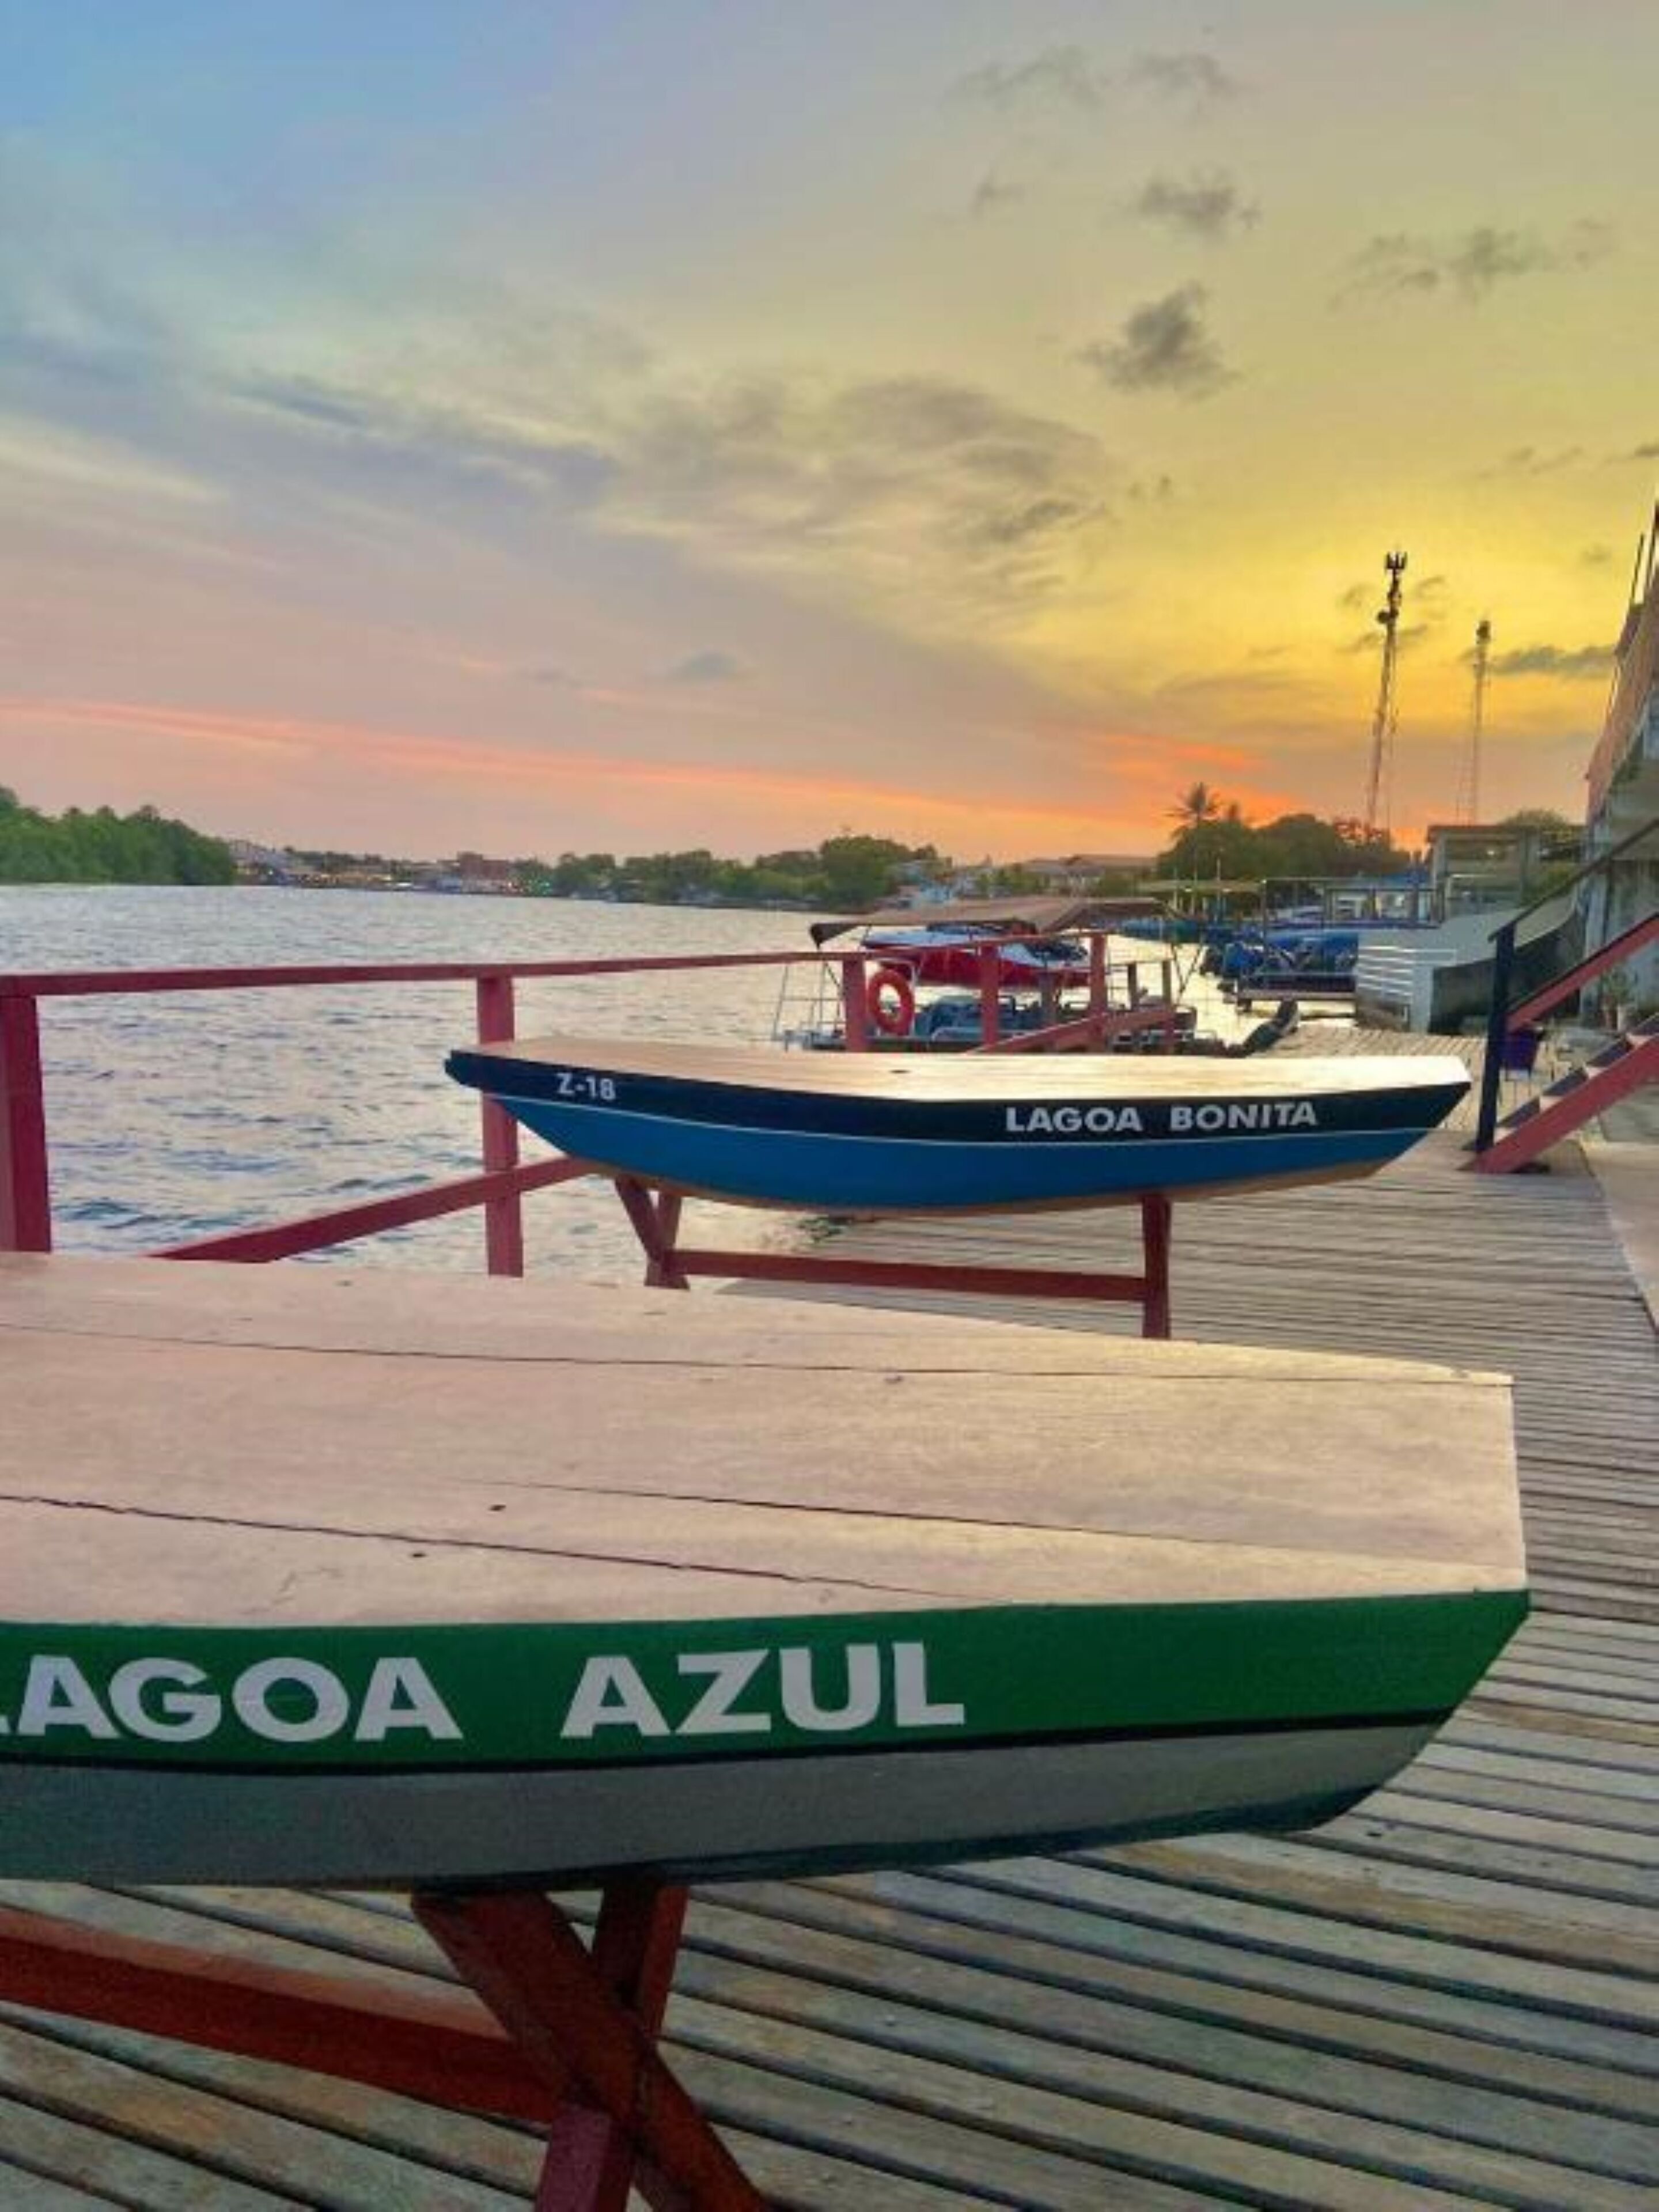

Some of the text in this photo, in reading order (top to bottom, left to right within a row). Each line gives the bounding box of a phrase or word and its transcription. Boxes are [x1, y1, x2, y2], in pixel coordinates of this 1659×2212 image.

[556, 1072, 616, 1101] Z-18
[1005, 1101, 1317, 1132] LAGOA BONITA
[0, 1642, 965, 1743] AGOA AZUL
